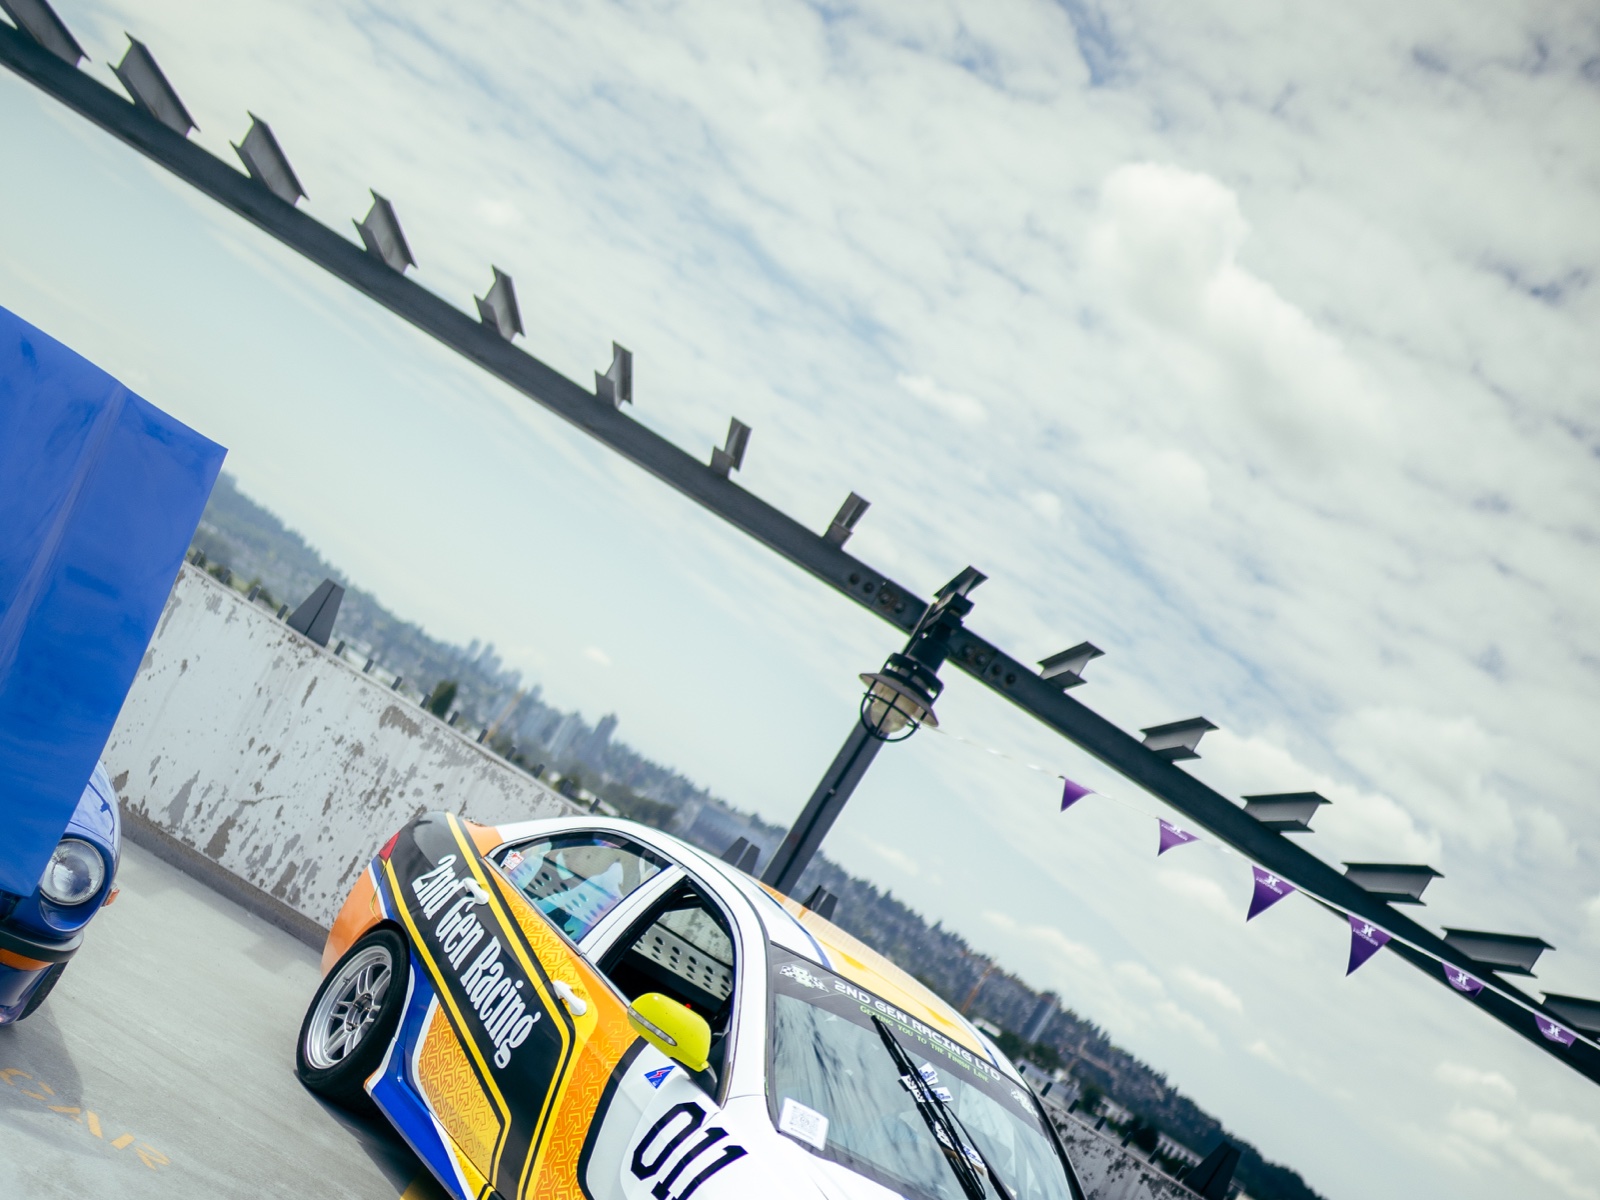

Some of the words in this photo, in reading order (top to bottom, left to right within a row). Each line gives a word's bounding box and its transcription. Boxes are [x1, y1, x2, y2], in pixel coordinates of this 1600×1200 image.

[411, 854, 464, 920] 2nd
[435, 896, 485, 971] Gen
[460, 935, 541, 1069] Racing
[834, 981, 871, 1004] 2ND
[875, 1000, 907, 1023] GEN
[912, 1020, 972, 1061] RACING
[975, 1058, 1001, 1081] LTD
[0, 1067, 171, 1170] CAR
